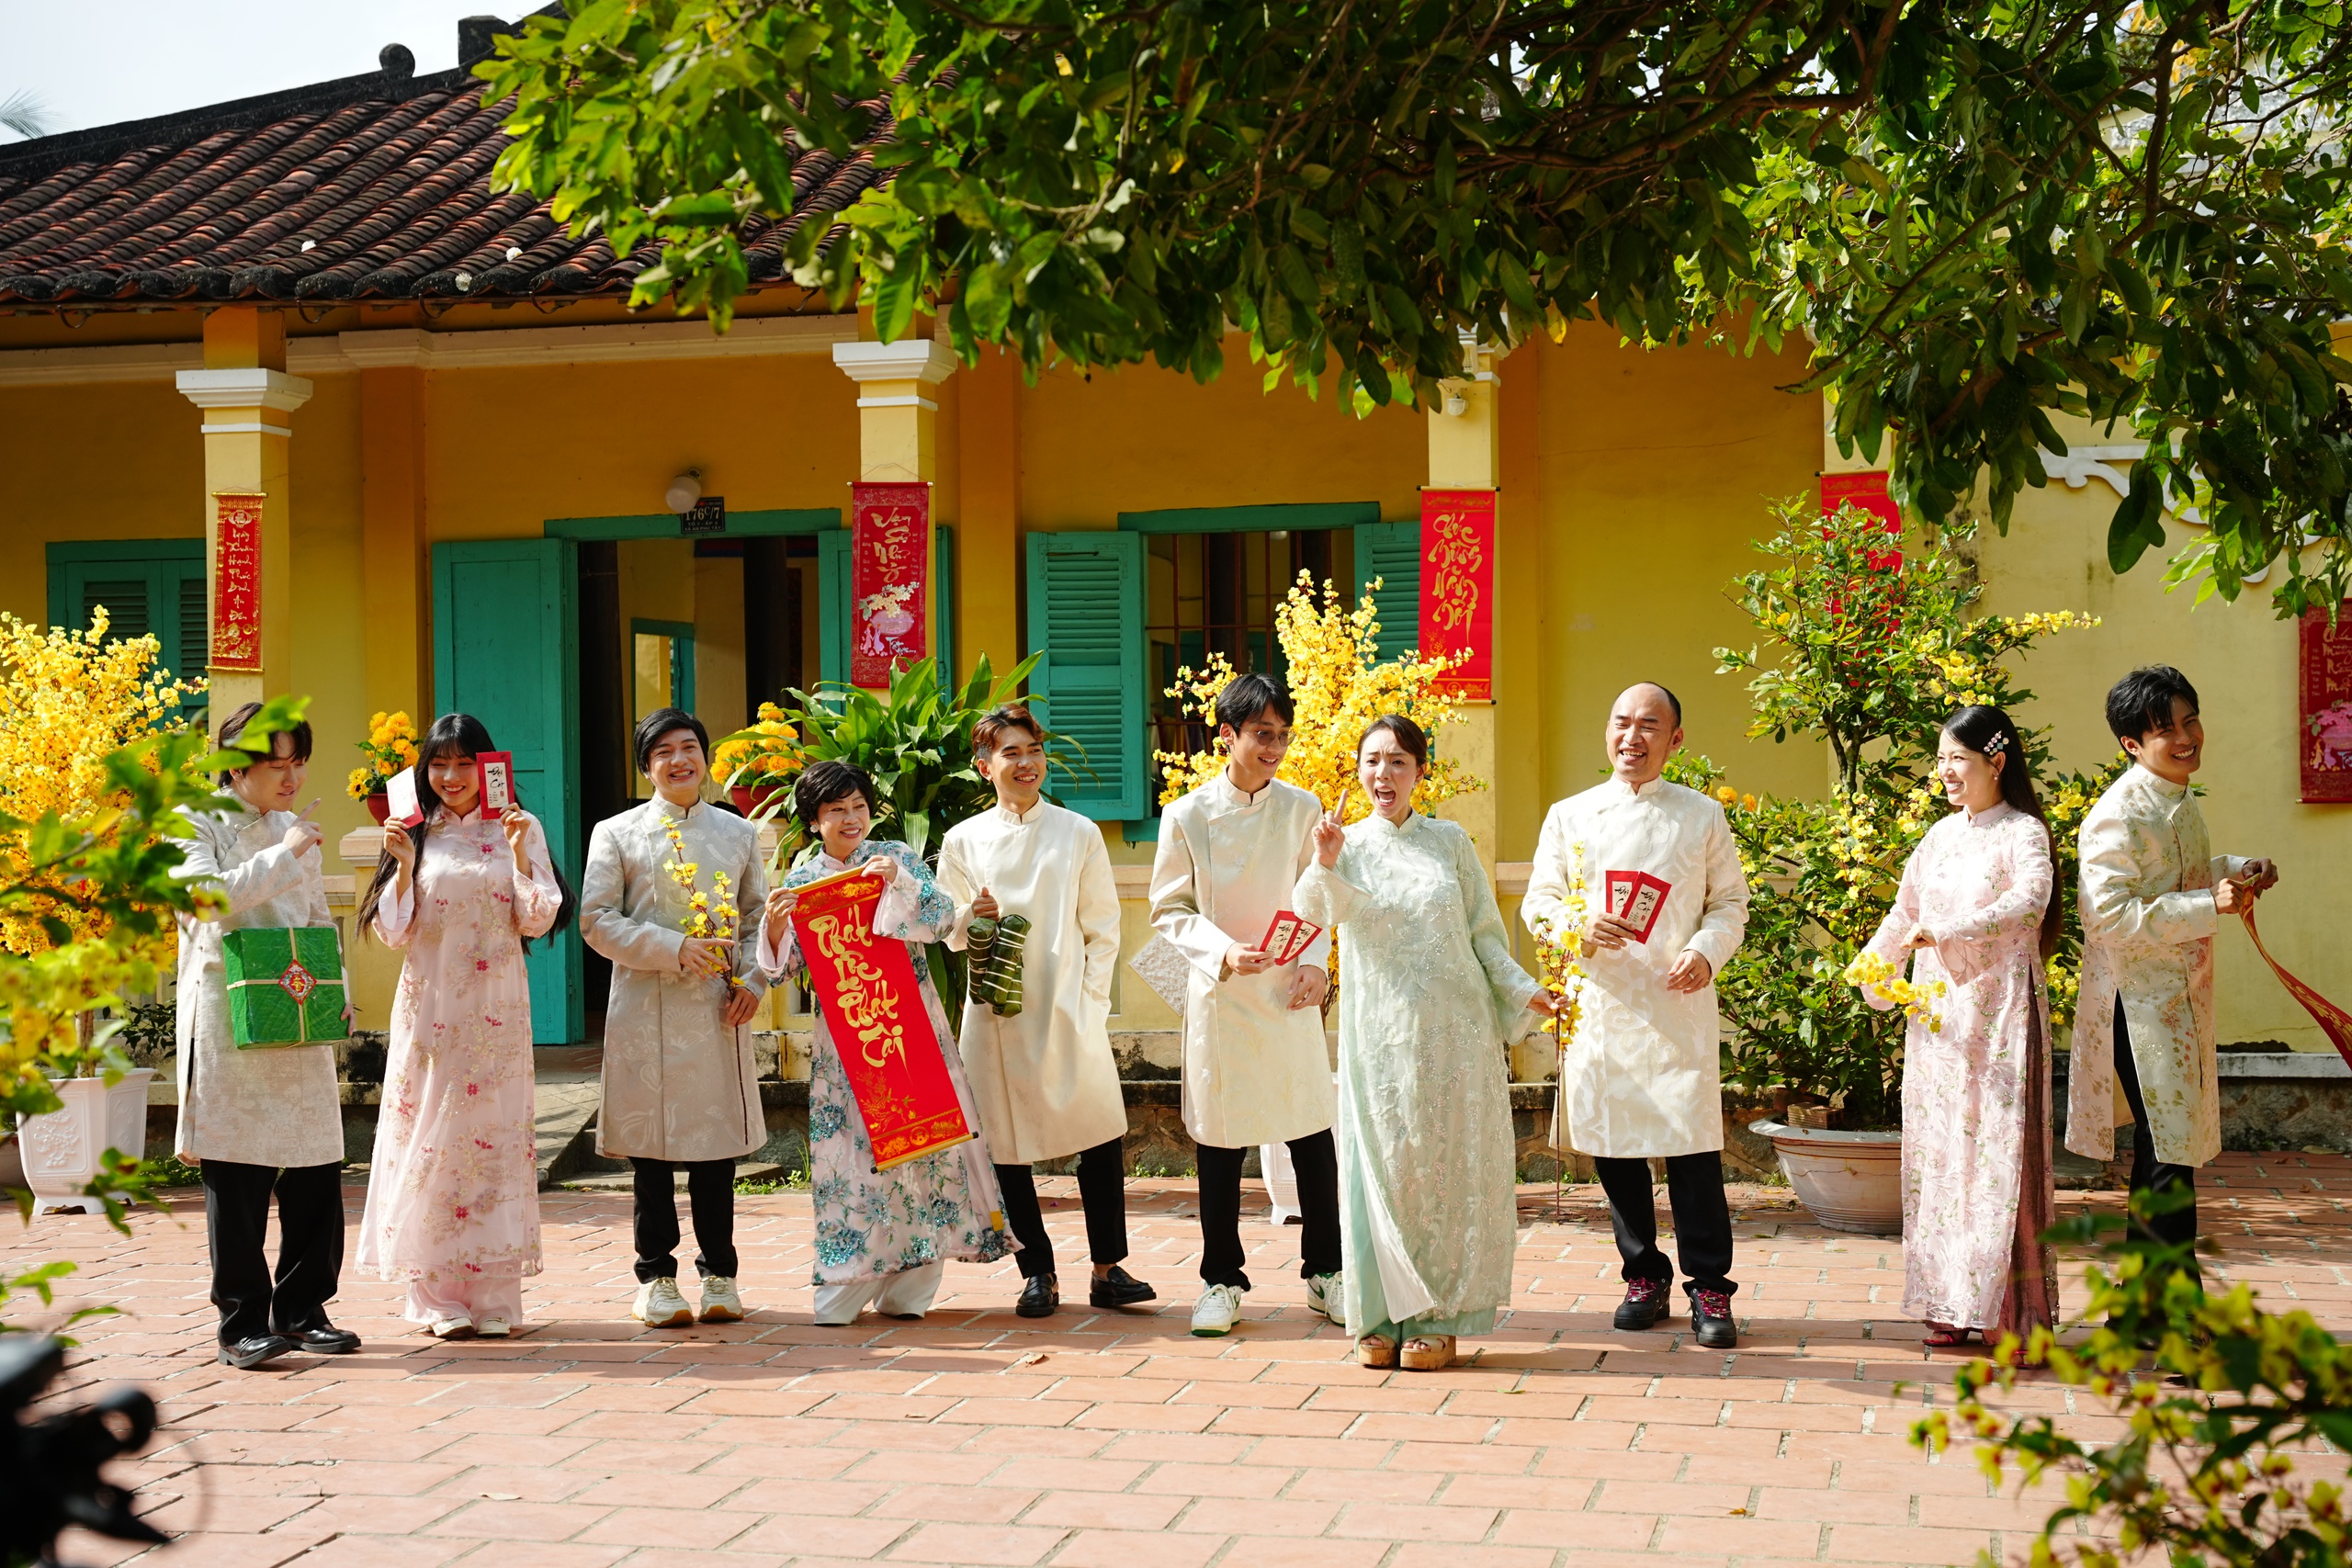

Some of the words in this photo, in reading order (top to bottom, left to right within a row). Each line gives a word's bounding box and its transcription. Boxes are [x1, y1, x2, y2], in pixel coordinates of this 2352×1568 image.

[870, 506, 911, 528] Vạn
[1432, 512, 1481, 544] Chúc
[228, 554, 253, 567] Hạnh
[873, 541, 911, 565] Như
[1428, 538, 1483, 573] Mừng
[1432, 564, 1479, 603] Năm
[1432, 592, 1477, 647] Mới
[808, 904, 873, 958] Phát
[835, 950, 883, 992] Lộc
[837, 979, 899, 1028] Phát
[857, 1021, 914, 1086] Tài
